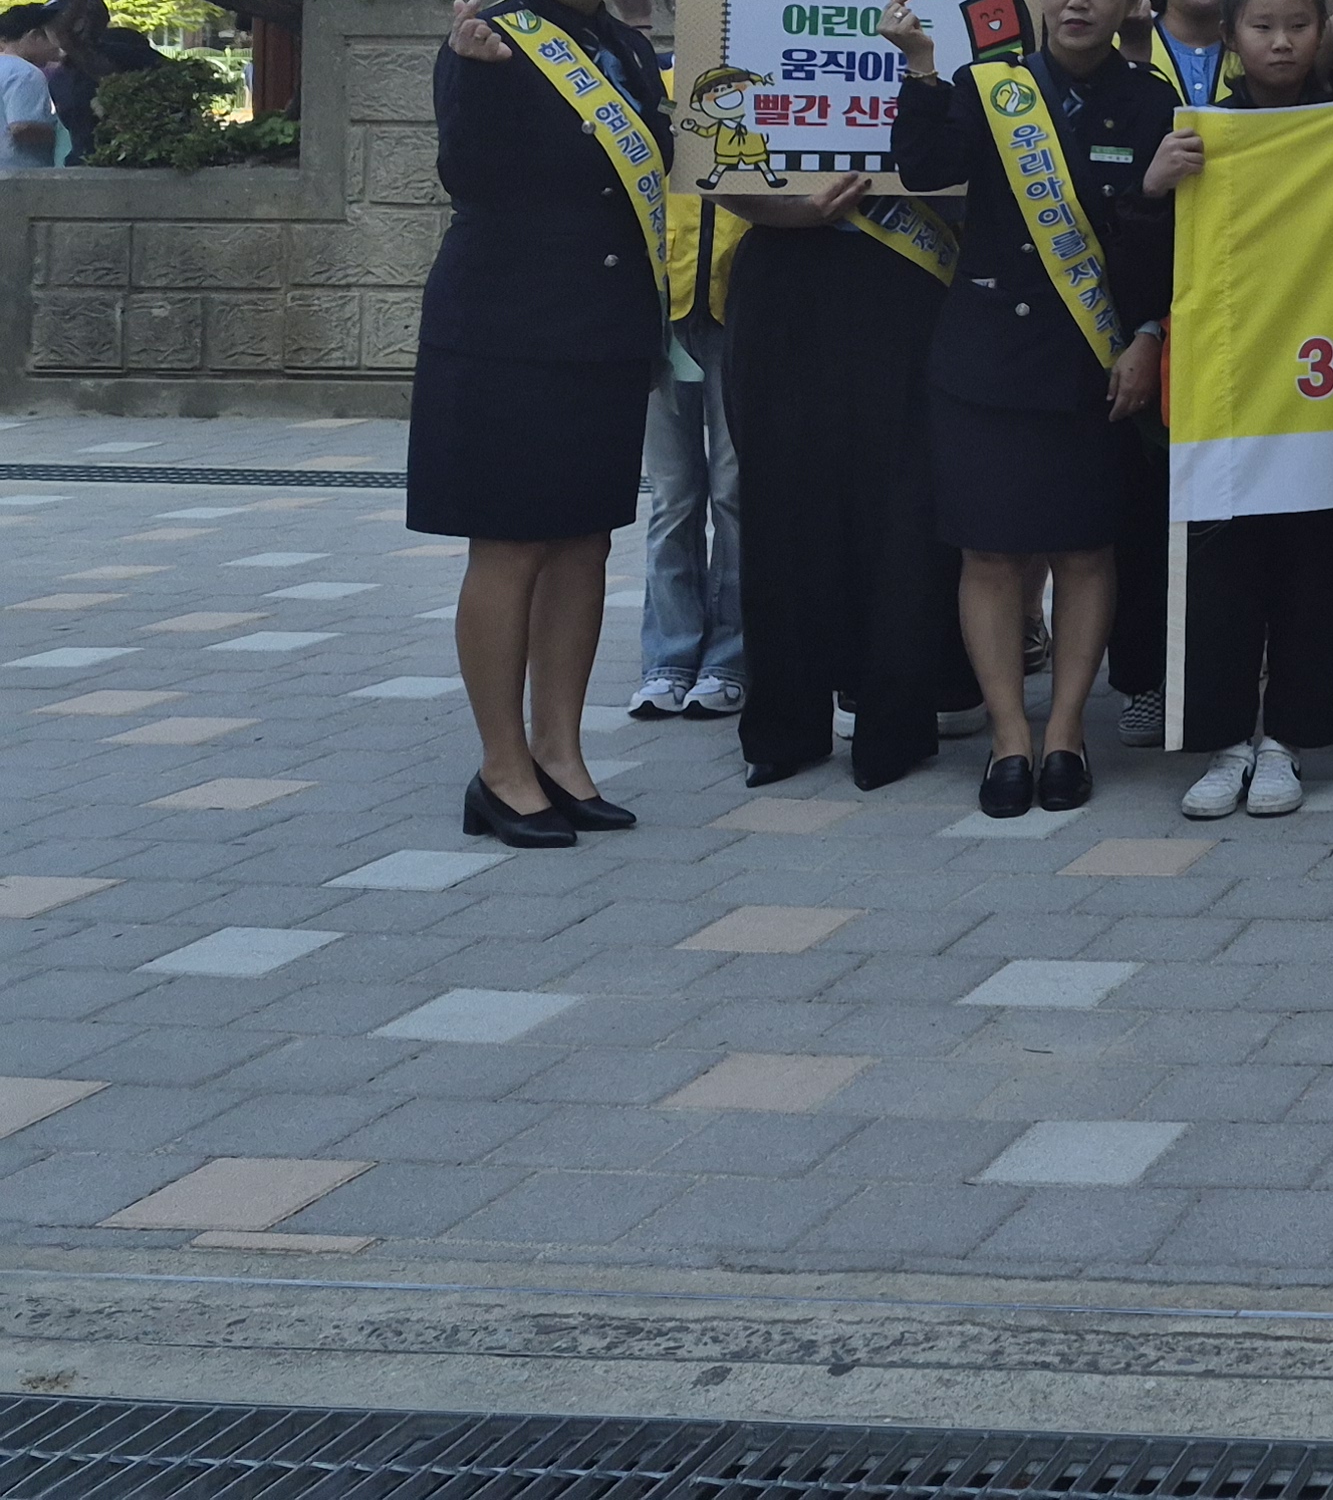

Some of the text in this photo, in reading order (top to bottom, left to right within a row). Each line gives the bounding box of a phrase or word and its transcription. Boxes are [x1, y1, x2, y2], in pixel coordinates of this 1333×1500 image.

[538, 37, 602, 97] 학교
[753, 94, 829, 127] 빨간
[1010, 124, 1087, 261] 우리아이를
